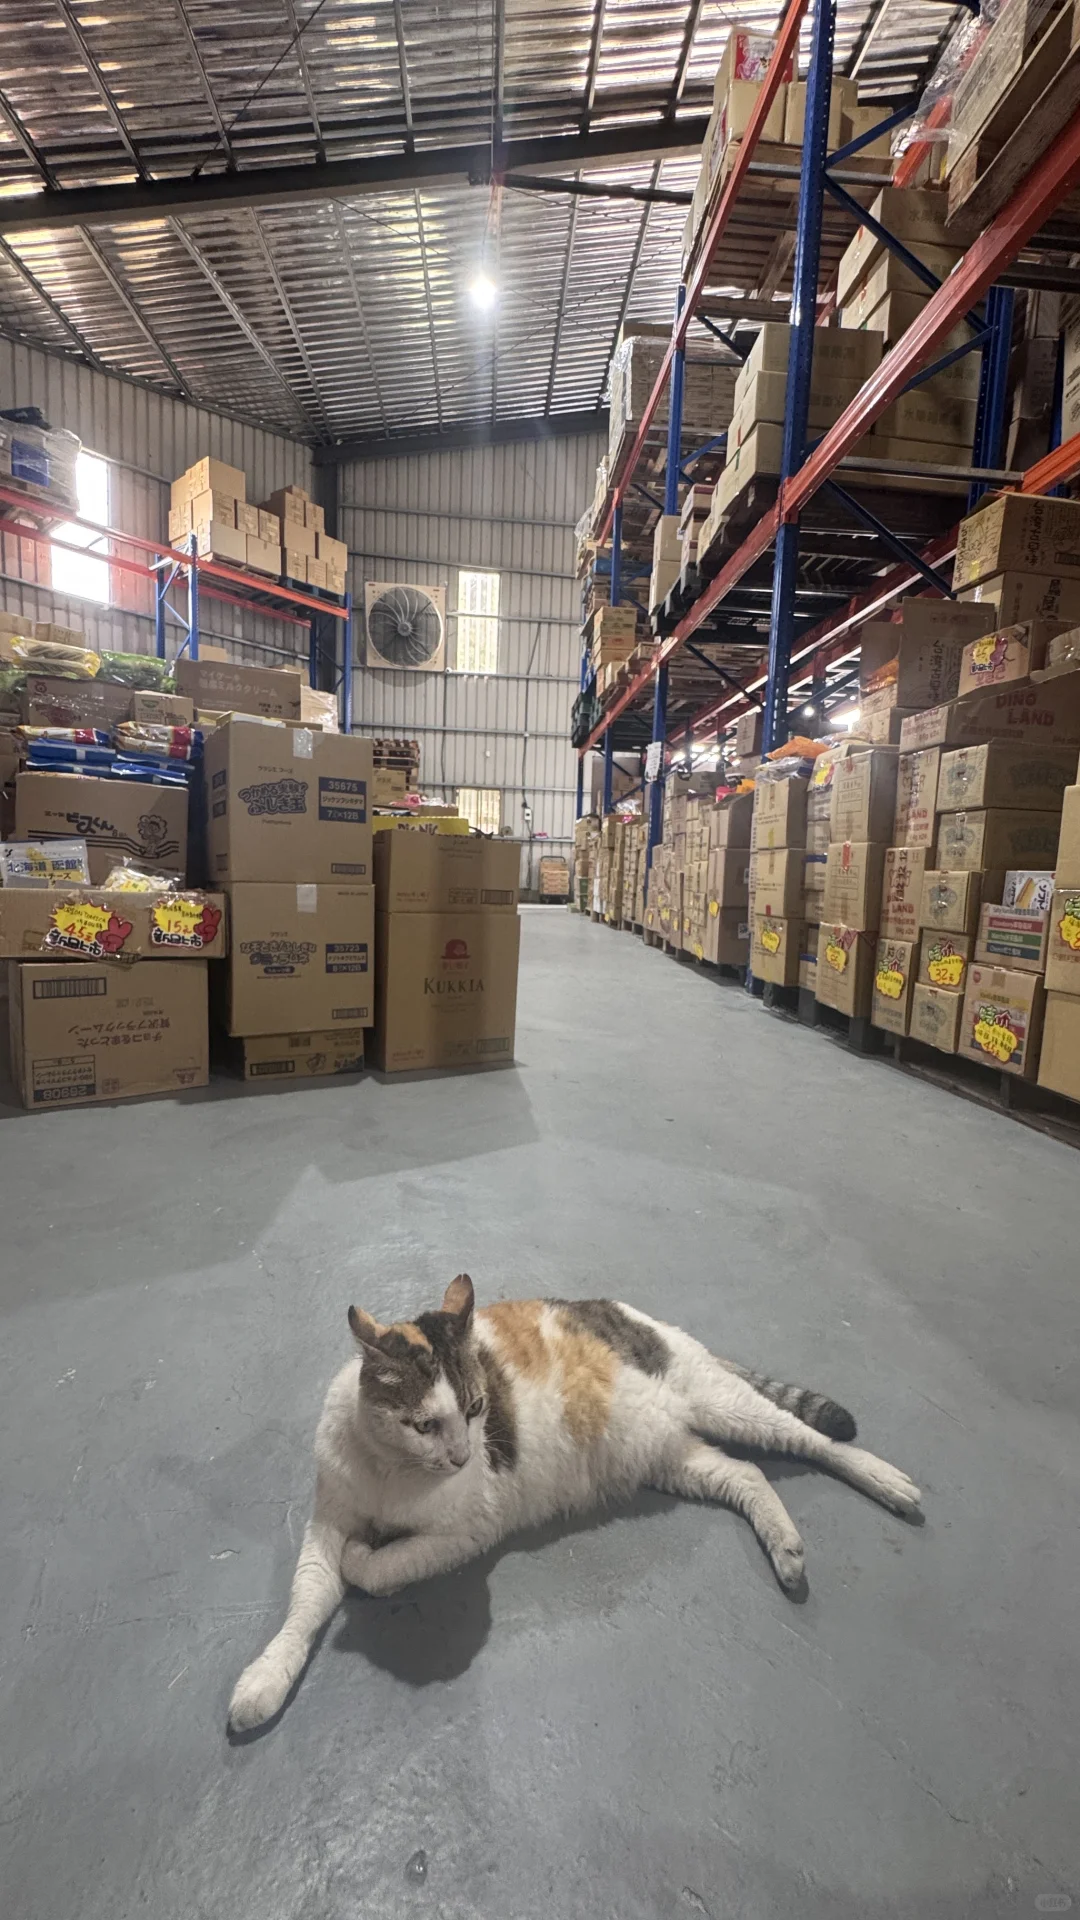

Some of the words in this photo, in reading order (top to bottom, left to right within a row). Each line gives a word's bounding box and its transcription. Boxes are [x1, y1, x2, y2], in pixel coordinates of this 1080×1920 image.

[996, 693, 1038, 709] DINO
[1007, 709, 1056, 727] LAND
[327, 780, 358, 792] 35675
[7, 859, 47, 873] 北海道
[892, 903, 914, 914] LAND
[63, 922, 93, 943] 45元
[424, 977, 485, 995] KUKKIA
